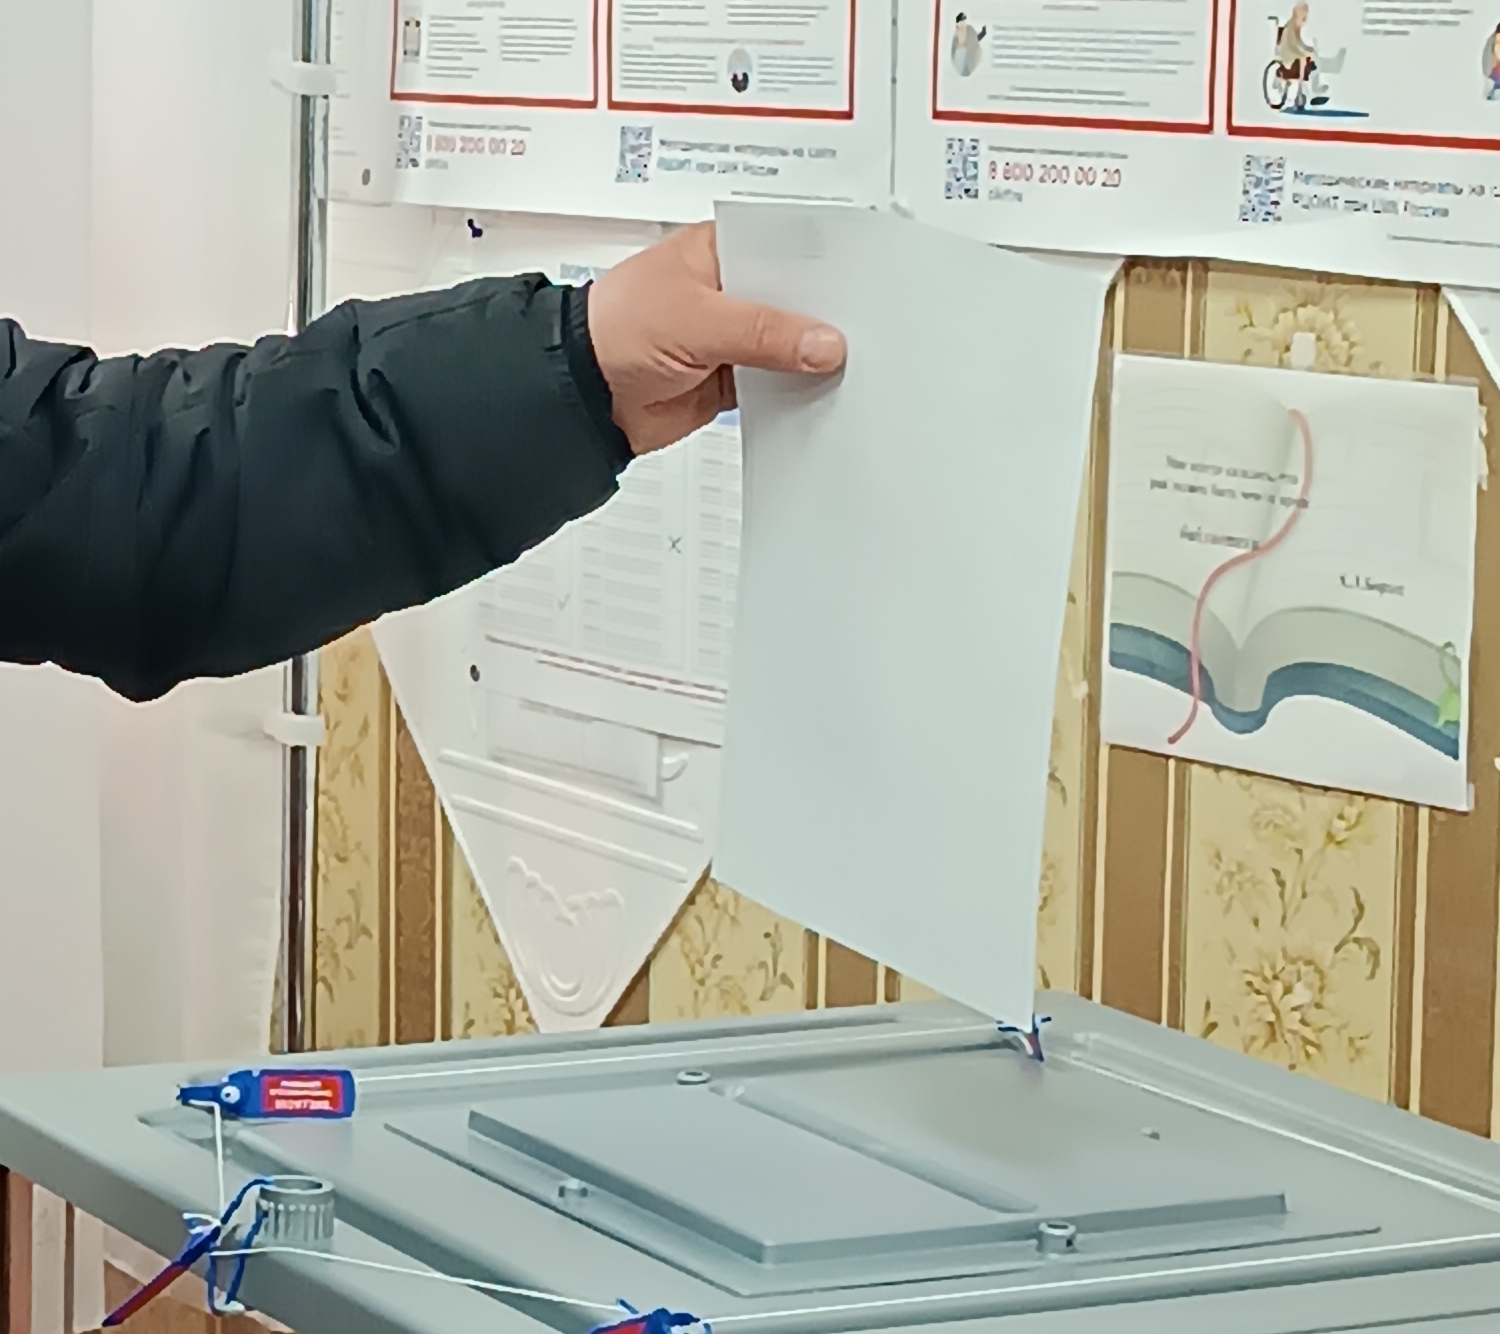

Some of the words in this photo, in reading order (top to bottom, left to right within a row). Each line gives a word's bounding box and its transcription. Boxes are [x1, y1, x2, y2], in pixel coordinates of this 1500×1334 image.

[1038, 163, 1070, 185] 200
[1074, 165, 1098, 186] 00
[1100, 167, 1122, 188] 20
